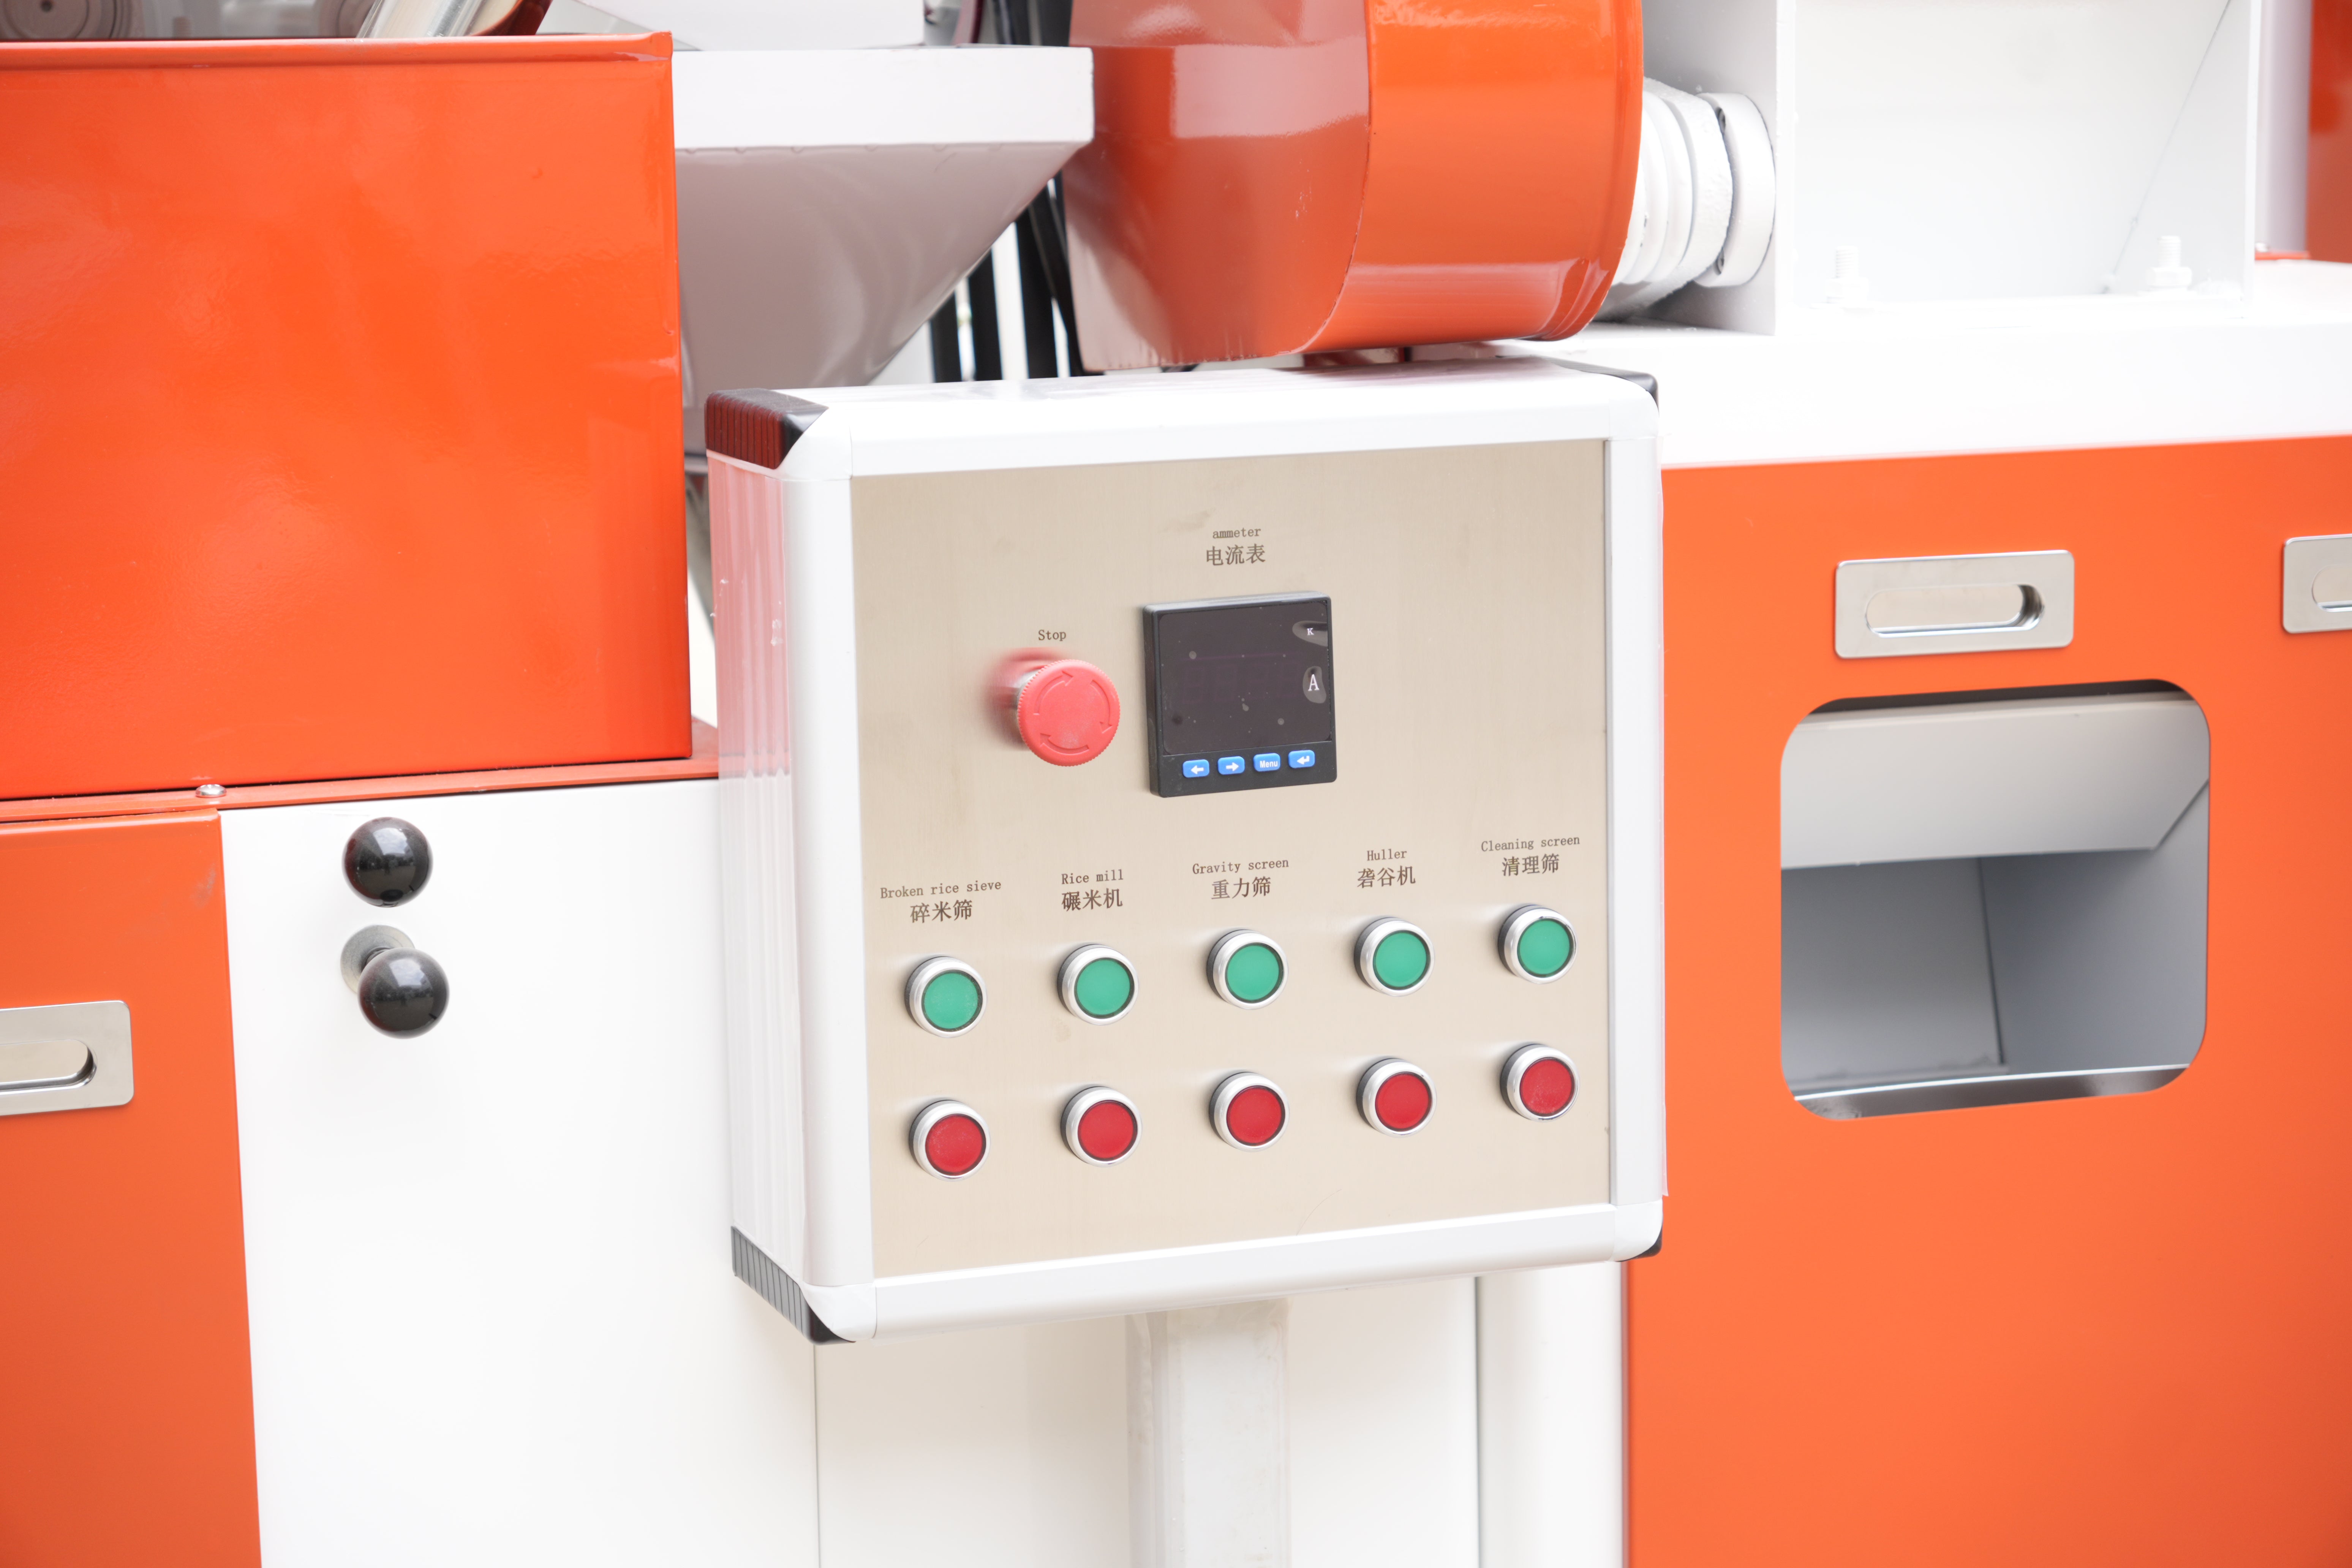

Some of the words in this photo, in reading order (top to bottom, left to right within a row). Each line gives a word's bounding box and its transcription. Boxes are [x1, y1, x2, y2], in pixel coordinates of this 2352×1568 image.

[1212, 528, 1261, 539] ammeter
[1206, 543, 1266, 566] 电流表
[1038, 629, 1066, 641] Stop
[1308, 674, 1320, 691] A
[1481, 838, 1534, 852] Cleaning
[1541, 837, 1580, 847] screen
[1367, 849, 1407, 861] Huller
[1192, 861, 1241, 875] Gravity
[1248, 860, 1289, 870] screen
[1502, 853, 1559, 876] 清理筛
[1061, 873, 1089, 885] Rice
[1096, 869, 1124, 882] mill
[1357, 865, 1416, 888] 砻谷机
[880, 885, 924, 899] Broken
[931, 883, 959, 895] rice
[967, 880, 1001, 892] sieve
[1211, 876, 1271, 899] 重力筛
[1061, 888, 1123, 912] 碾米机
[910, 899, 972, 923] 碎米筛
